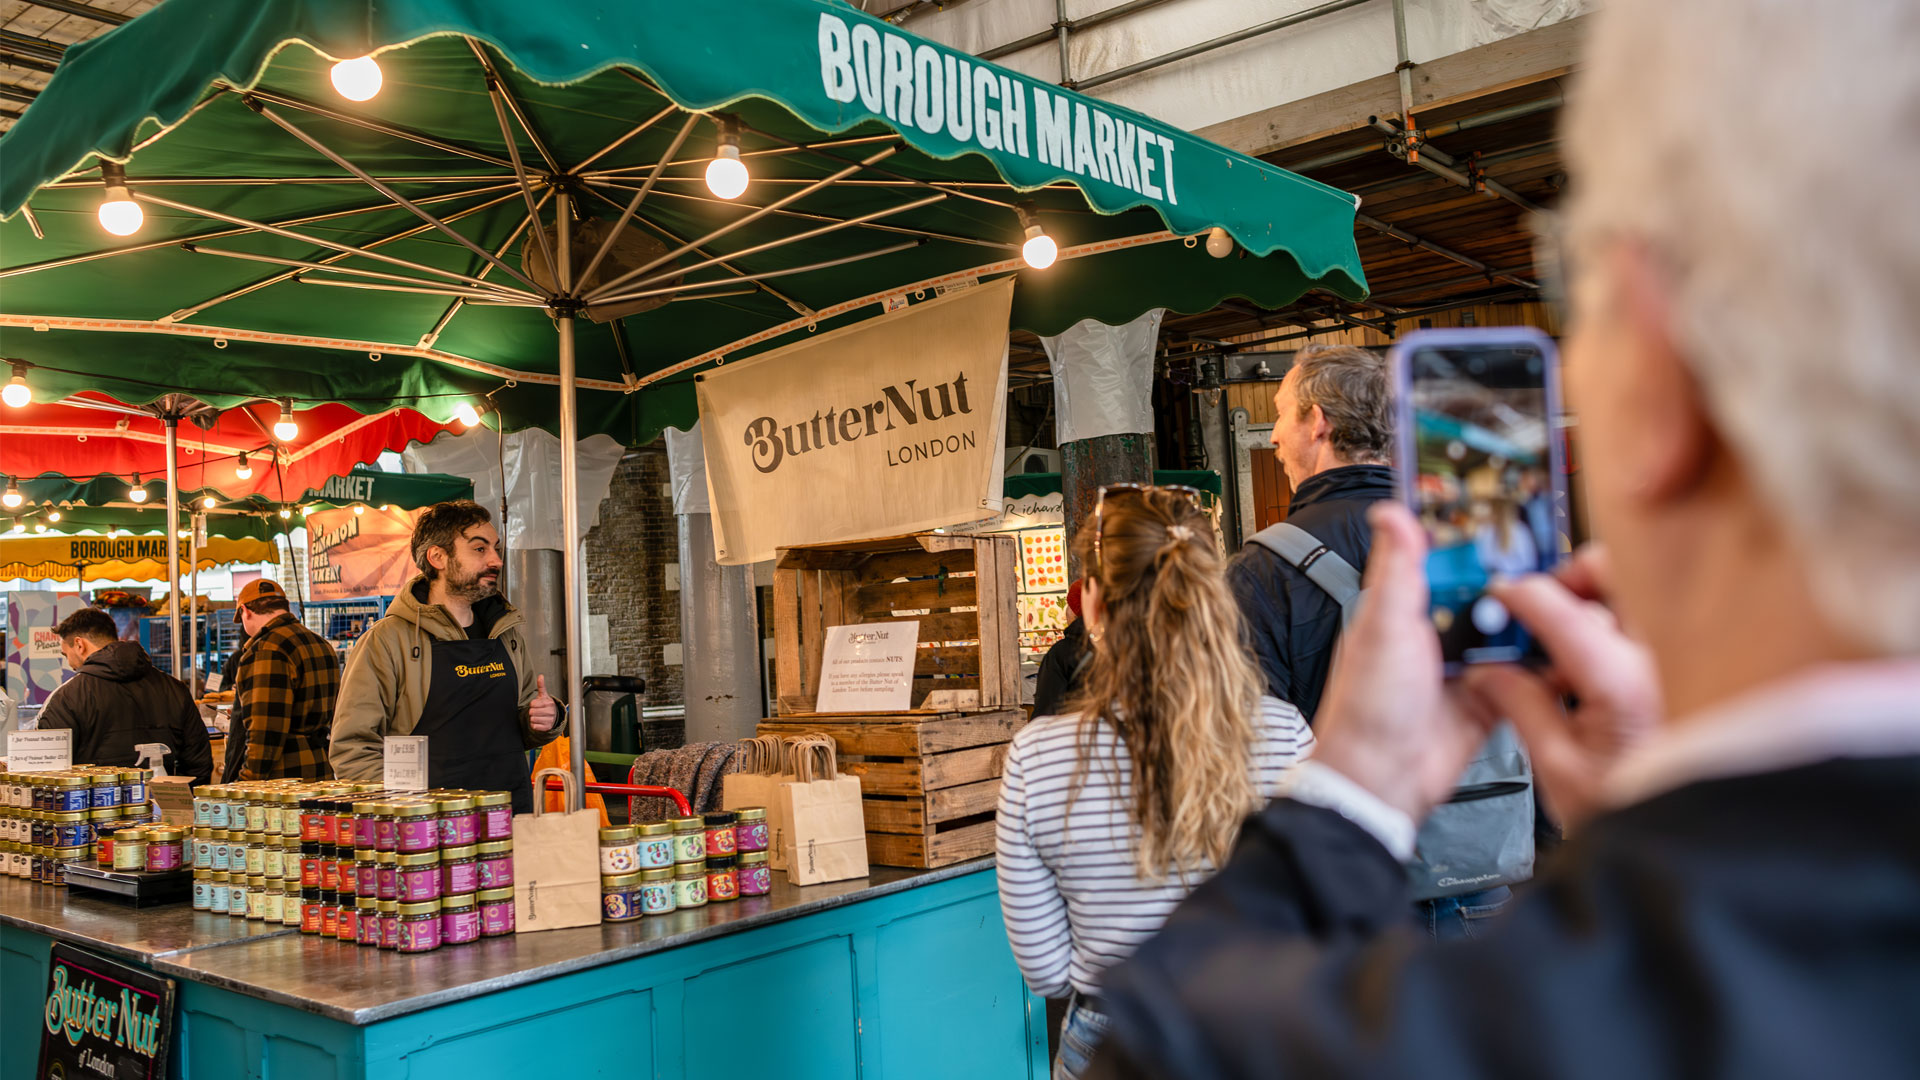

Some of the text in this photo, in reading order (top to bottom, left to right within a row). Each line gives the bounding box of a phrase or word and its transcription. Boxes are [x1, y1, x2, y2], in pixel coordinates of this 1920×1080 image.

[818, 12, 1178, 206] BOROUGH MARKET
[743, 371, 973, 474] ButterNut
[887, 430, 977, 467] LONDON
[70, 540, 191, 559] BOROUGH MARET
[35, 640, 60, 650] Picas
[45, 964, 160, 1059] Butter Nut
[85, 1047, 116, 1078] London
